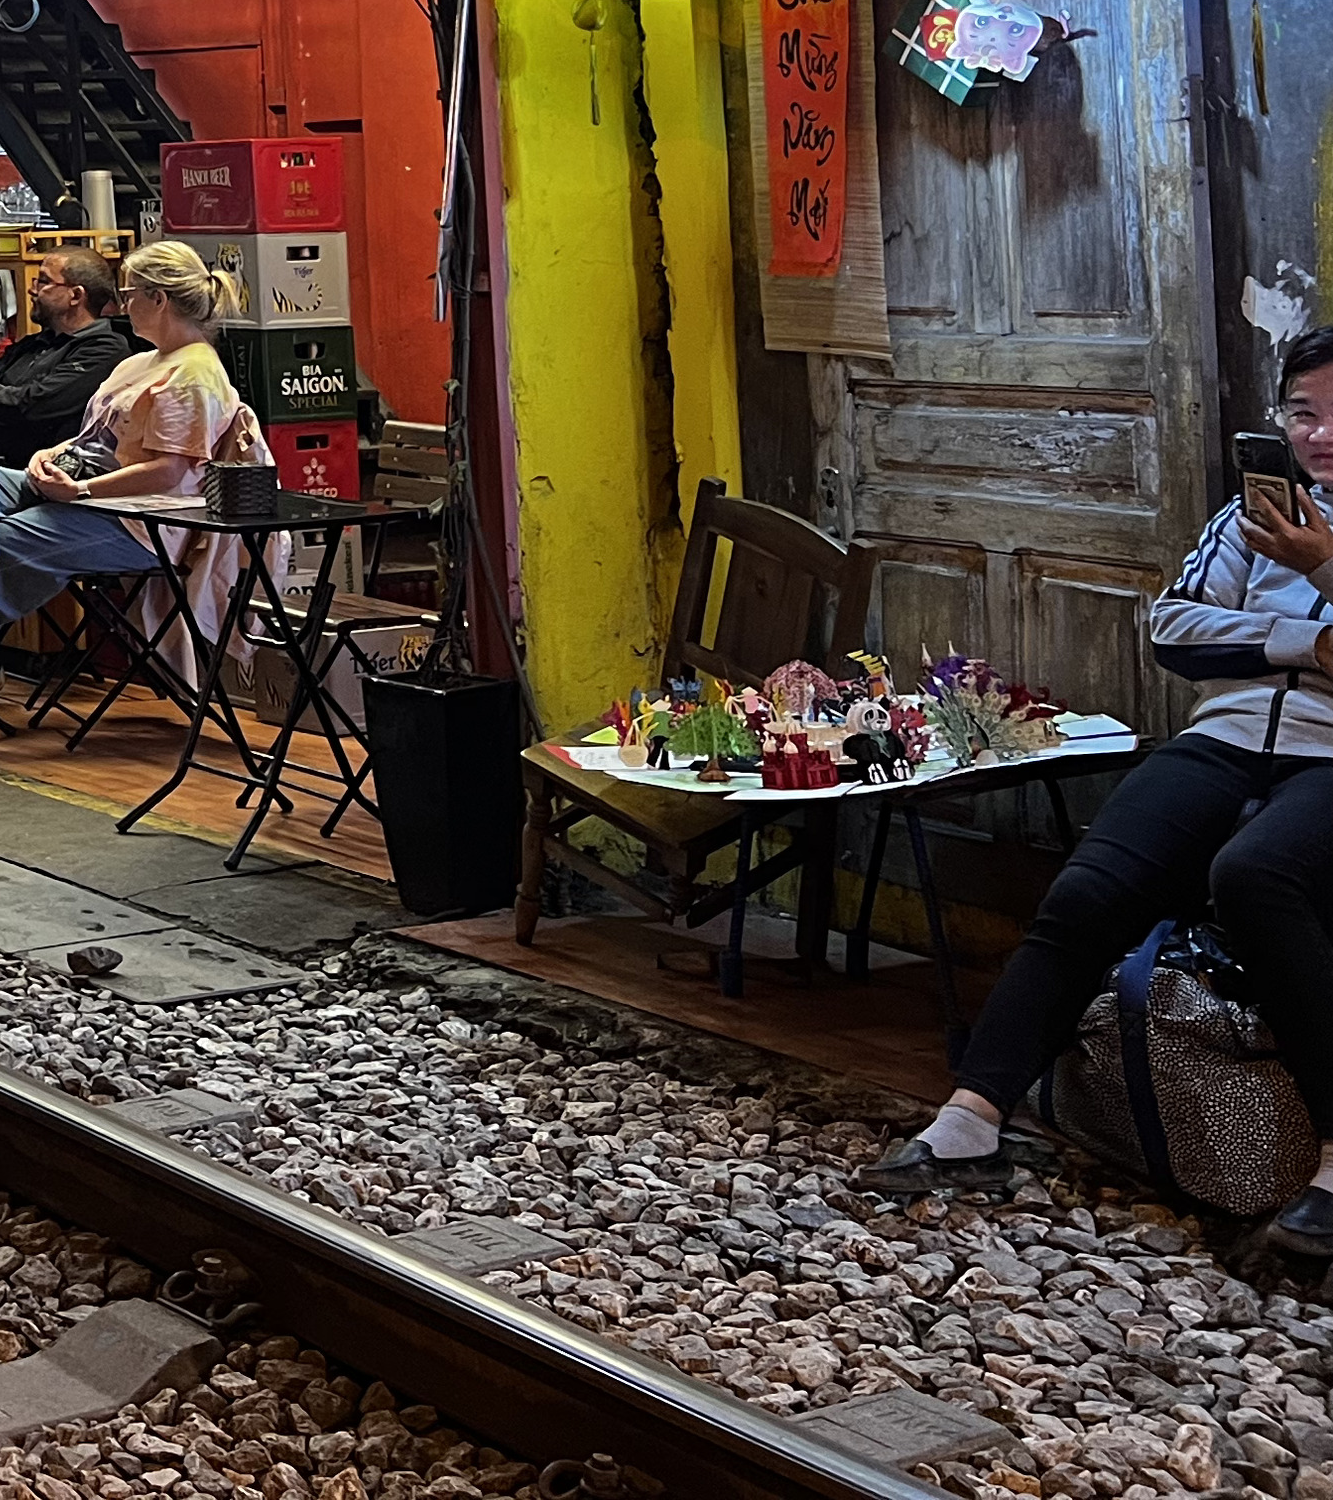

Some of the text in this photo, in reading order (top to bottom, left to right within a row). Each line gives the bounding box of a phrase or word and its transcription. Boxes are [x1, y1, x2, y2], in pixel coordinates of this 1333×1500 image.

[182, 167, 208, 189] HANOI
[302, 365, 322, 376] BIA
[281, 375, 345, 396] SAIGON
